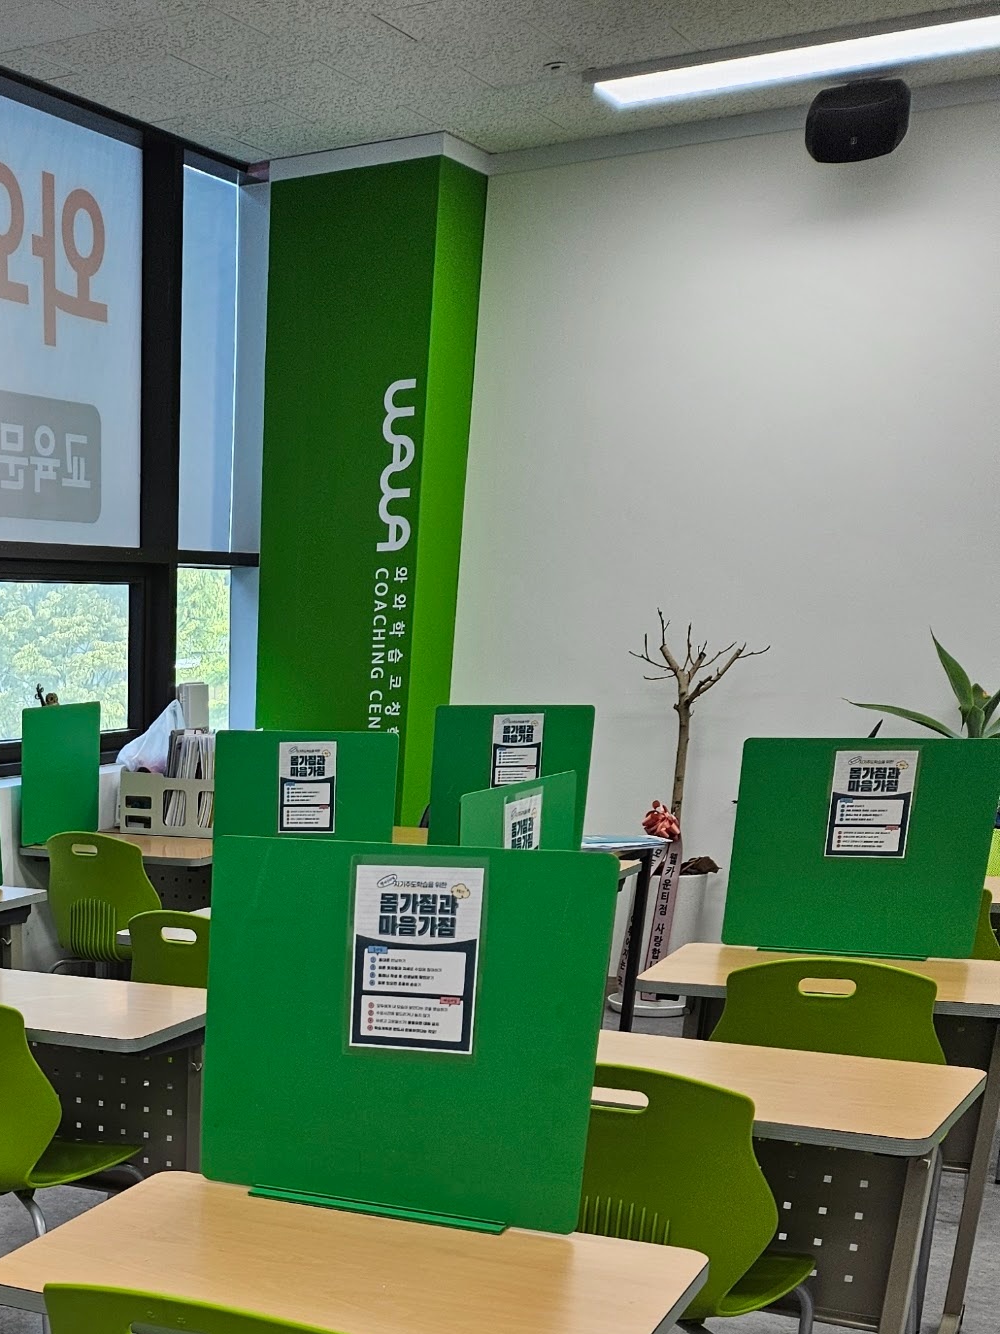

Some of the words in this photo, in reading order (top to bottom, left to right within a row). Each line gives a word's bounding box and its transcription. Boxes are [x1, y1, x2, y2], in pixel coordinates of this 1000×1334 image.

[370, 568, 389, 680] COACHING
[290, 755, 326, 766] 몸가짐과
[290, 766, 326, 777] 마음가짐
[849, 767, 901, 780] 몸가짐과
[847, 779, 899, 792] 마음가짐
[393, 880, 434, 889] 자기주도학습을
[435, 881, 448, 889] 위한
[379, 893, 459, 916] 몸가짐과
[378, 915, 457, 938] 마음가짐
